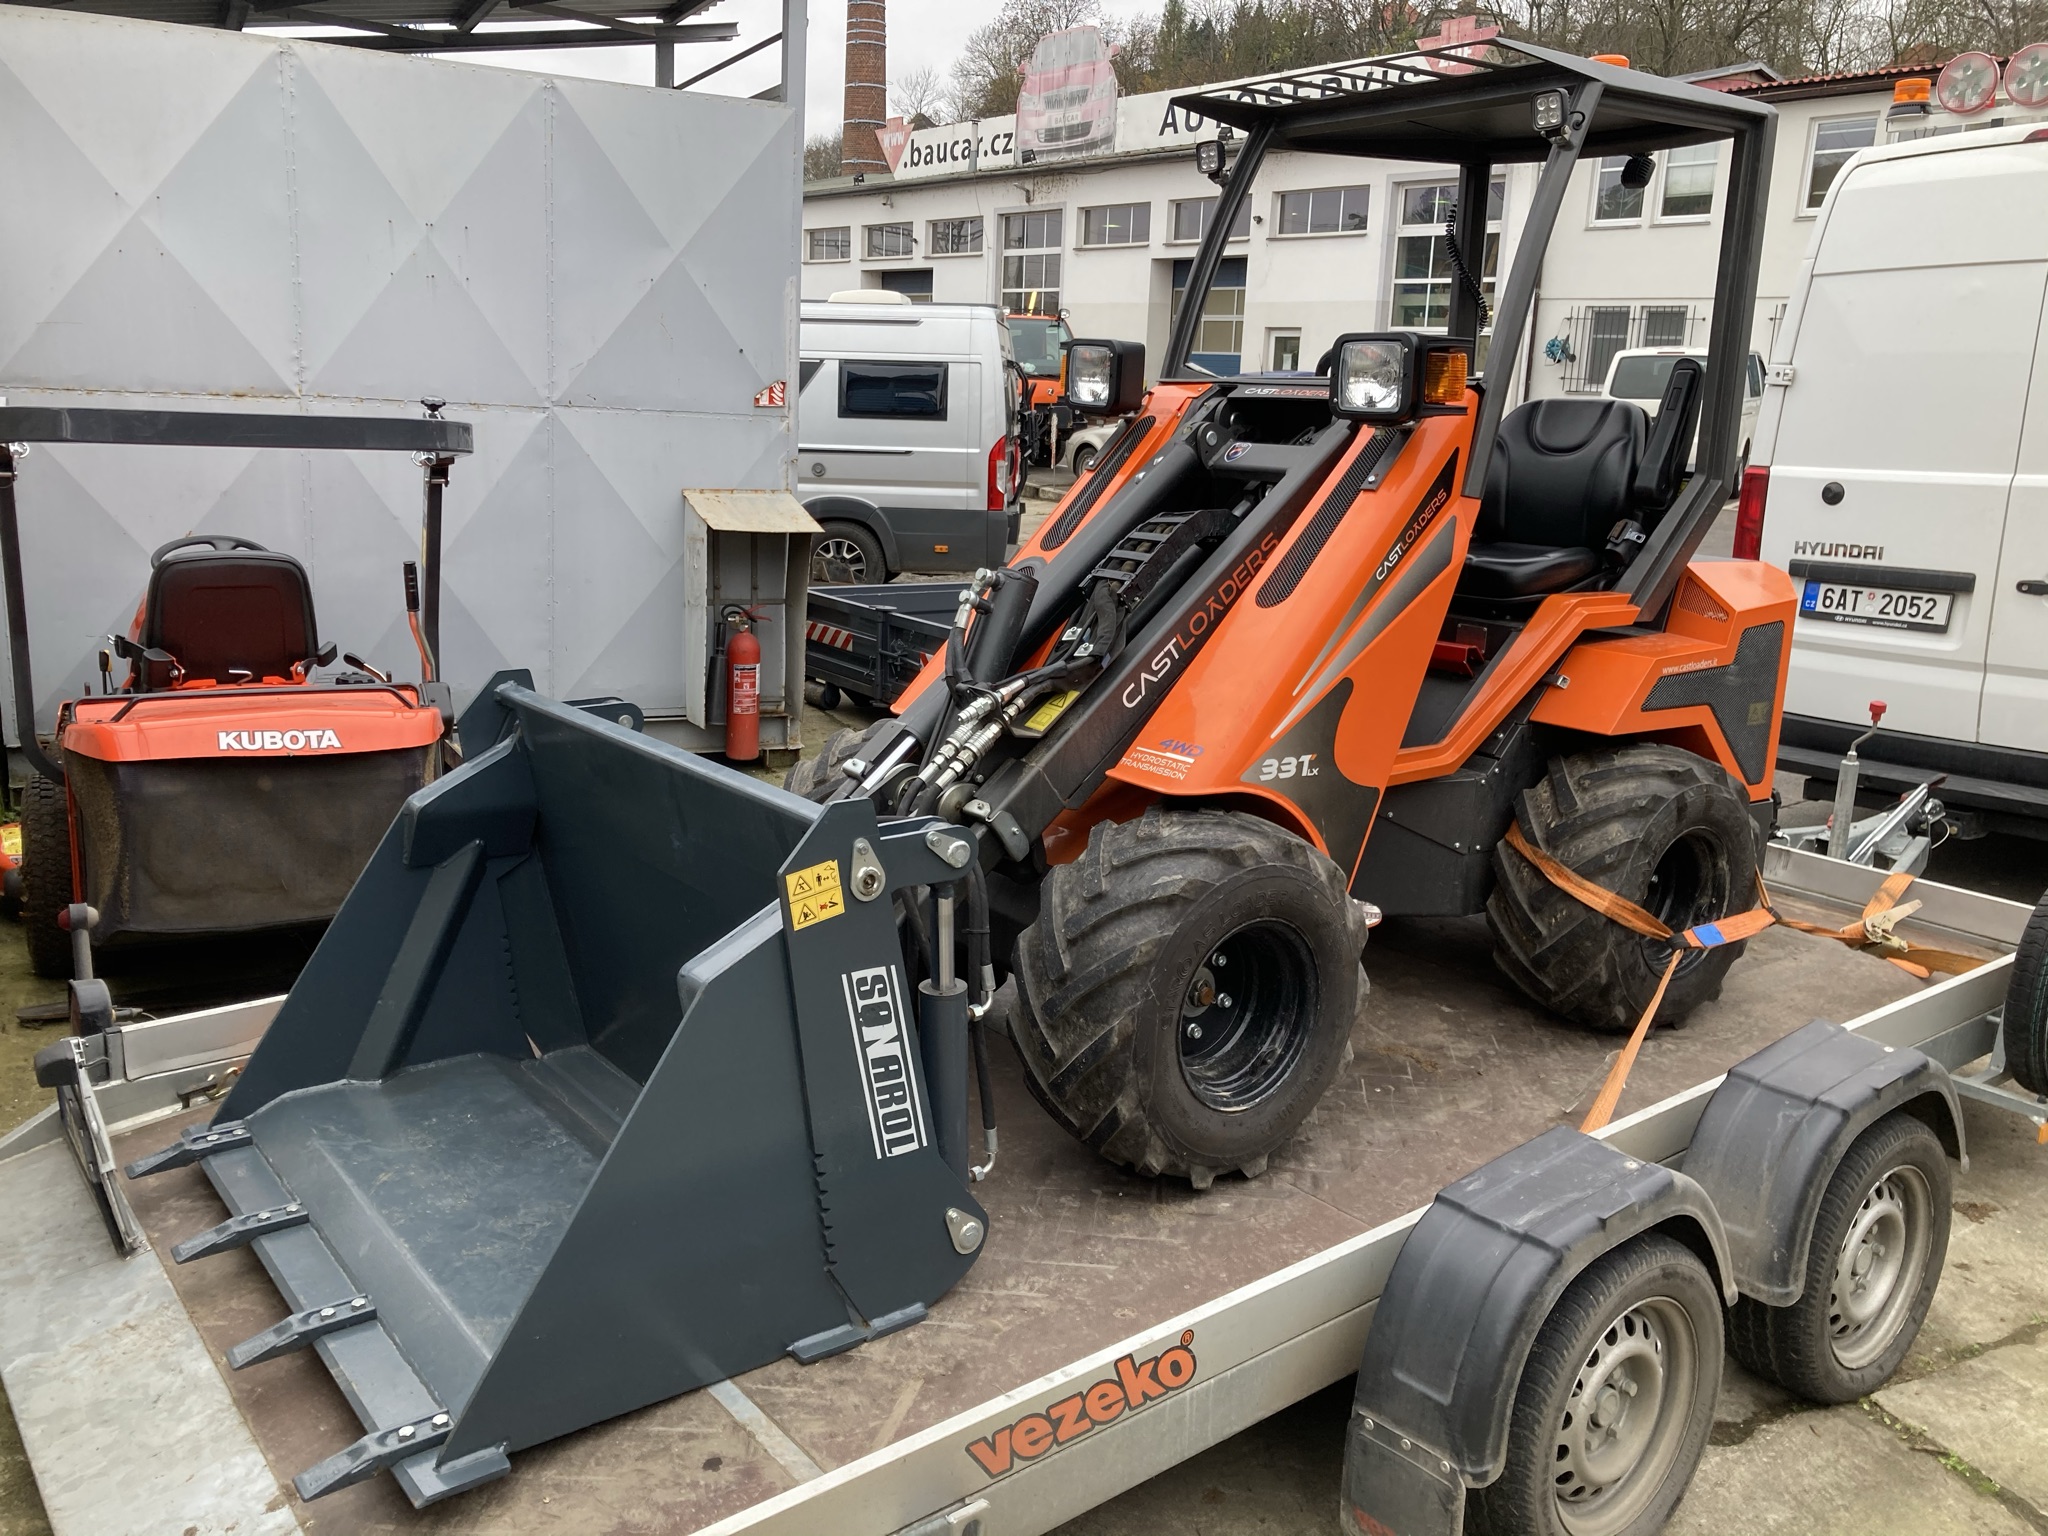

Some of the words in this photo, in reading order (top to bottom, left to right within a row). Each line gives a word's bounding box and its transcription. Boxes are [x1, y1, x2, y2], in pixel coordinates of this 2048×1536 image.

[1794, 540, 1885, 560] HYUNDAI
[1805, 599, 1816, 608] CZ
[1821, 588, 1863, 612] 6AT
[1878, 593, 1937, 620] 2052
[217, 728, 343, 750] KUBOTA
[1159, 738, 1205, 757] 4WD
[1120, 757, 1186, 781] TRANSMISSION
[1130, 751, 1191, 772] HYDROSTATIC
